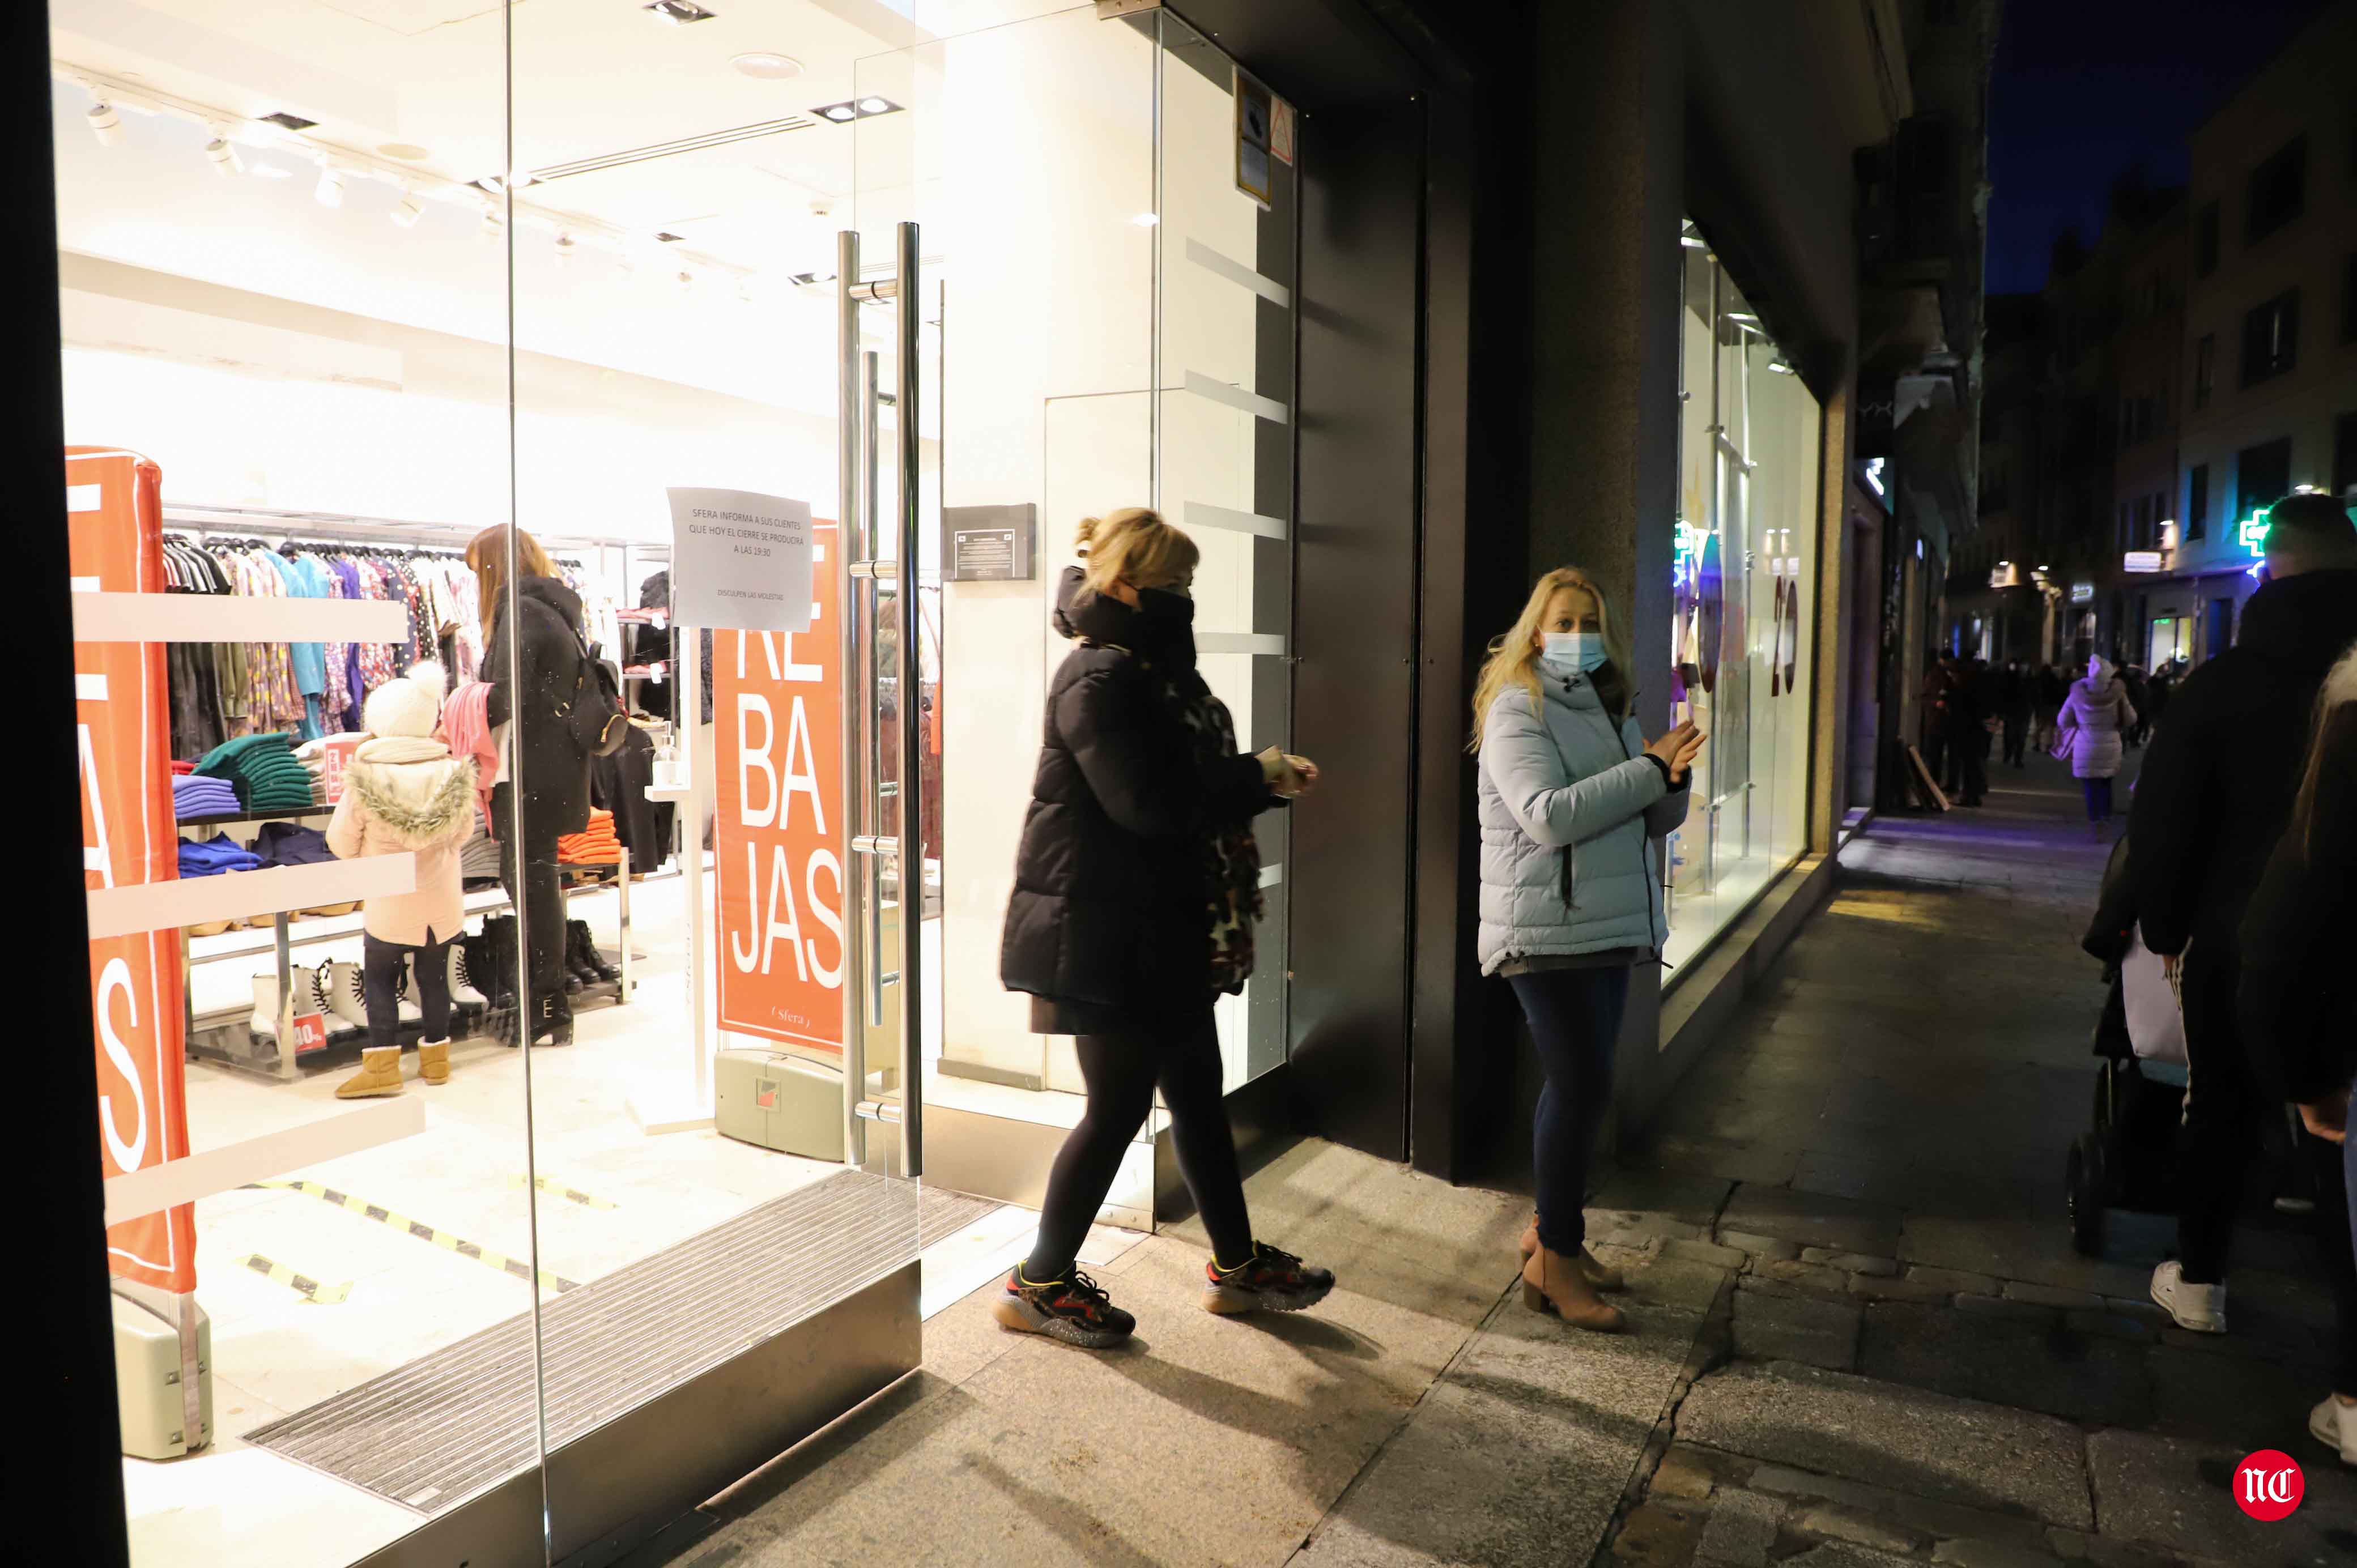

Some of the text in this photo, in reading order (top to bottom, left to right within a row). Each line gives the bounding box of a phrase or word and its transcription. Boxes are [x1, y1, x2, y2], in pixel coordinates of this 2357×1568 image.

[692, 509, 718, 519] SFERA
[720, 512, 753, 523] INFORMA
[761, 517, 773, 526] SUS
[774, 518, 801, 530] CLIENTES
[689, 525, 707, 534] QUE
[709, 526, 726, 535] HOY
[727, 527, 735, 537] EL
[737, 529, 760, 540] CIERRE
[761, 532, 769, 540] SE
[734, 545, 771, 557] A LAS 19:30
[717, 589, 747, 598] DISCULPEN
[757, 593, 784, 601] MOLESTIAS
[737, 693, 827, 835] BA
[731, 841, 843, 989] JAS
